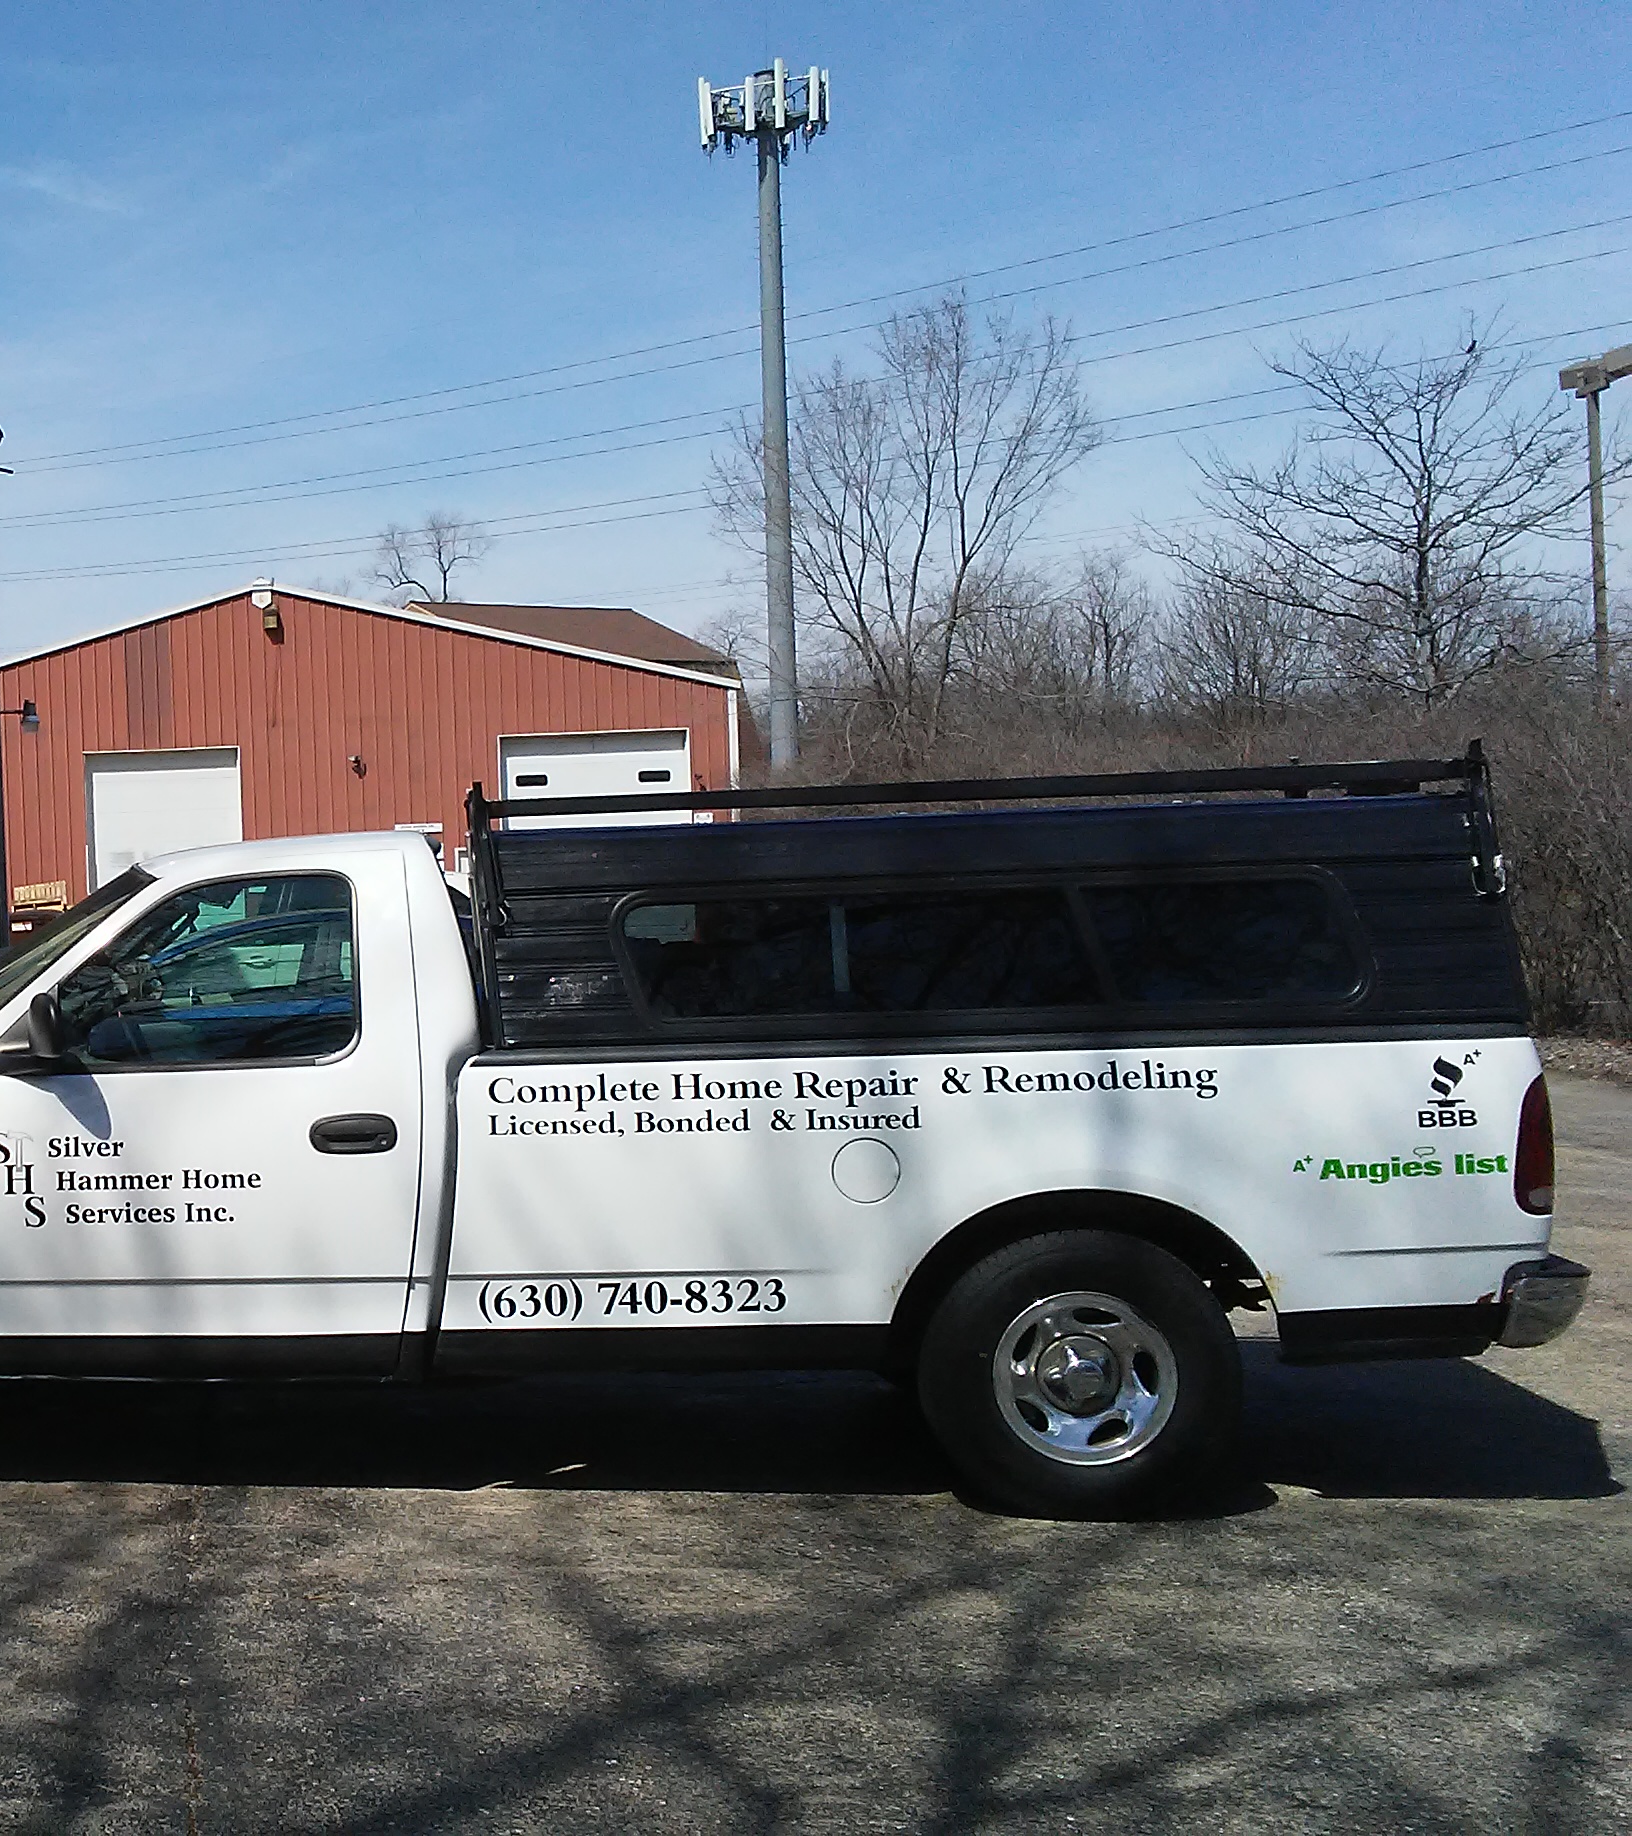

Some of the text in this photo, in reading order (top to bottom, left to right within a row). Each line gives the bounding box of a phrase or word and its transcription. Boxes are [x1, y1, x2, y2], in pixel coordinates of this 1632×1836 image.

[487, 1059, 1220, 1113] Complete Home Repair & Remodeling
[487, 1105, 924, 1138] Licensed, Bonded & Insured
[1417, 1109, 1479, 1128] BBB
[47, 1136, 125, 1158] Silver
[55, 1168, 263, 1192] Hammer Home
[1319, 1153, 1509, 1185] Angies list
[65, 1201, 236, 1225] Services Inc.
[478, 1277, 788, 1323] (630) 740-8323
